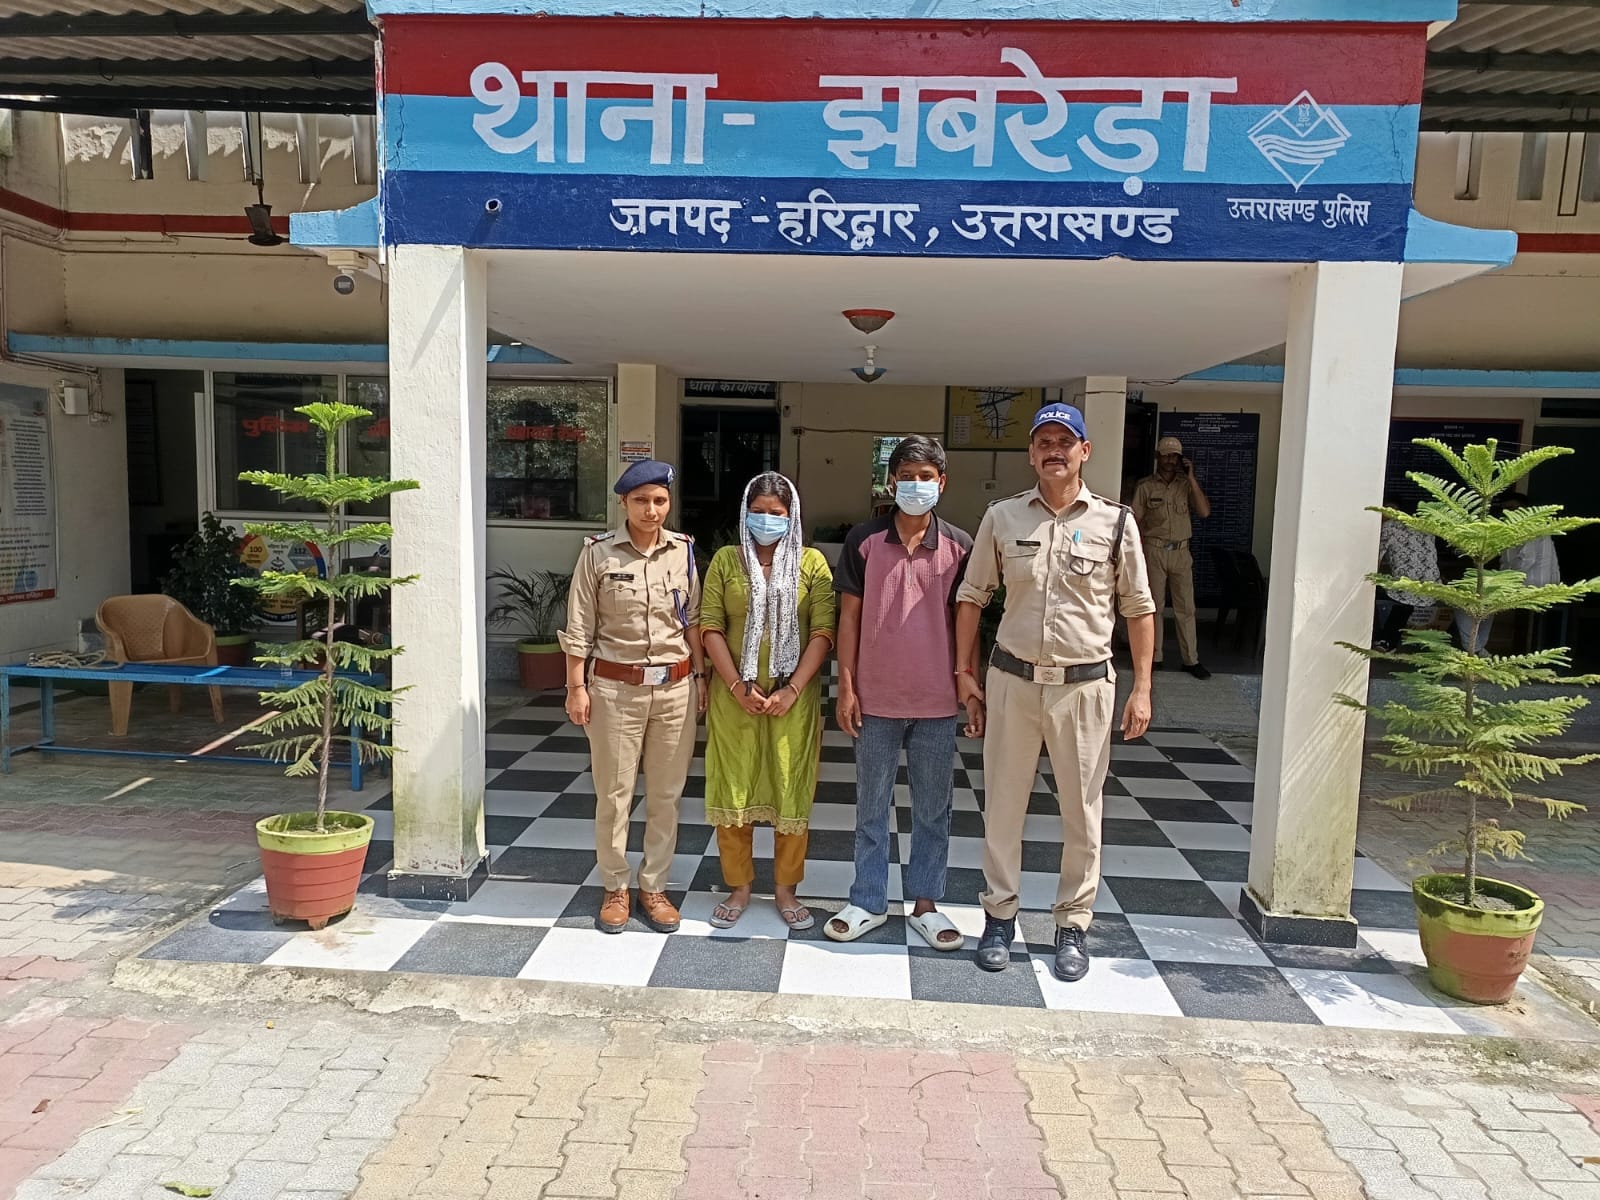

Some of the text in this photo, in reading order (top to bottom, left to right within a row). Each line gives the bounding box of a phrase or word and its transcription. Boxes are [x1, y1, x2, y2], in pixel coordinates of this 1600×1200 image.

[818, 47, 1238, 196] झबरेड़ा
[1227, 193, 1372, 228] उत्तराखण्ड पुलिस
[609, 198, 742, 244] जनपद
[951, 205, 1180, 248] उत्तराखण्ड
[689, 380, 718, 392] थाना
[1039, 410, 1072, 421] POLICE
[249, 545, 263, 553] 100
